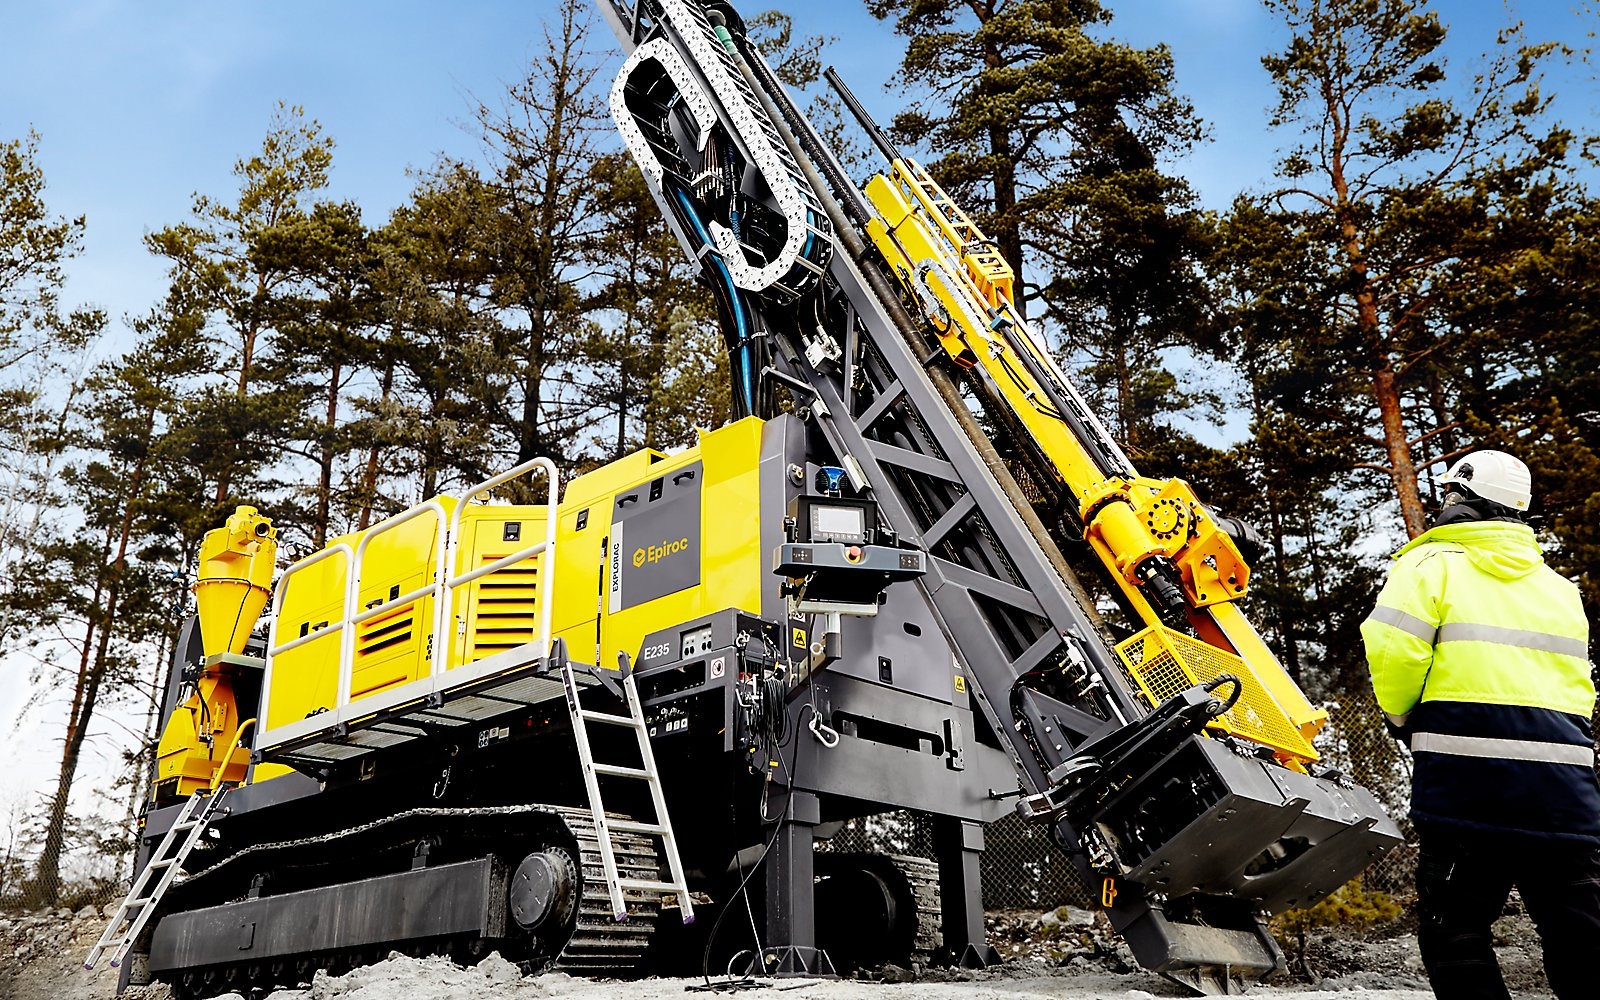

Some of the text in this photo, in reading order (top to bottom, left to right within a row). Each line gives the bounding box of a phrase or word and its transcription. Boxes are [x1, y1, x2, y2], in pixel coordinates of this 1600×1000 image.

[647, 537, 688, 564] Epiroc
[612, 543, 620, 592] EXPLORAC
[644, 643, 670, 660] E235
